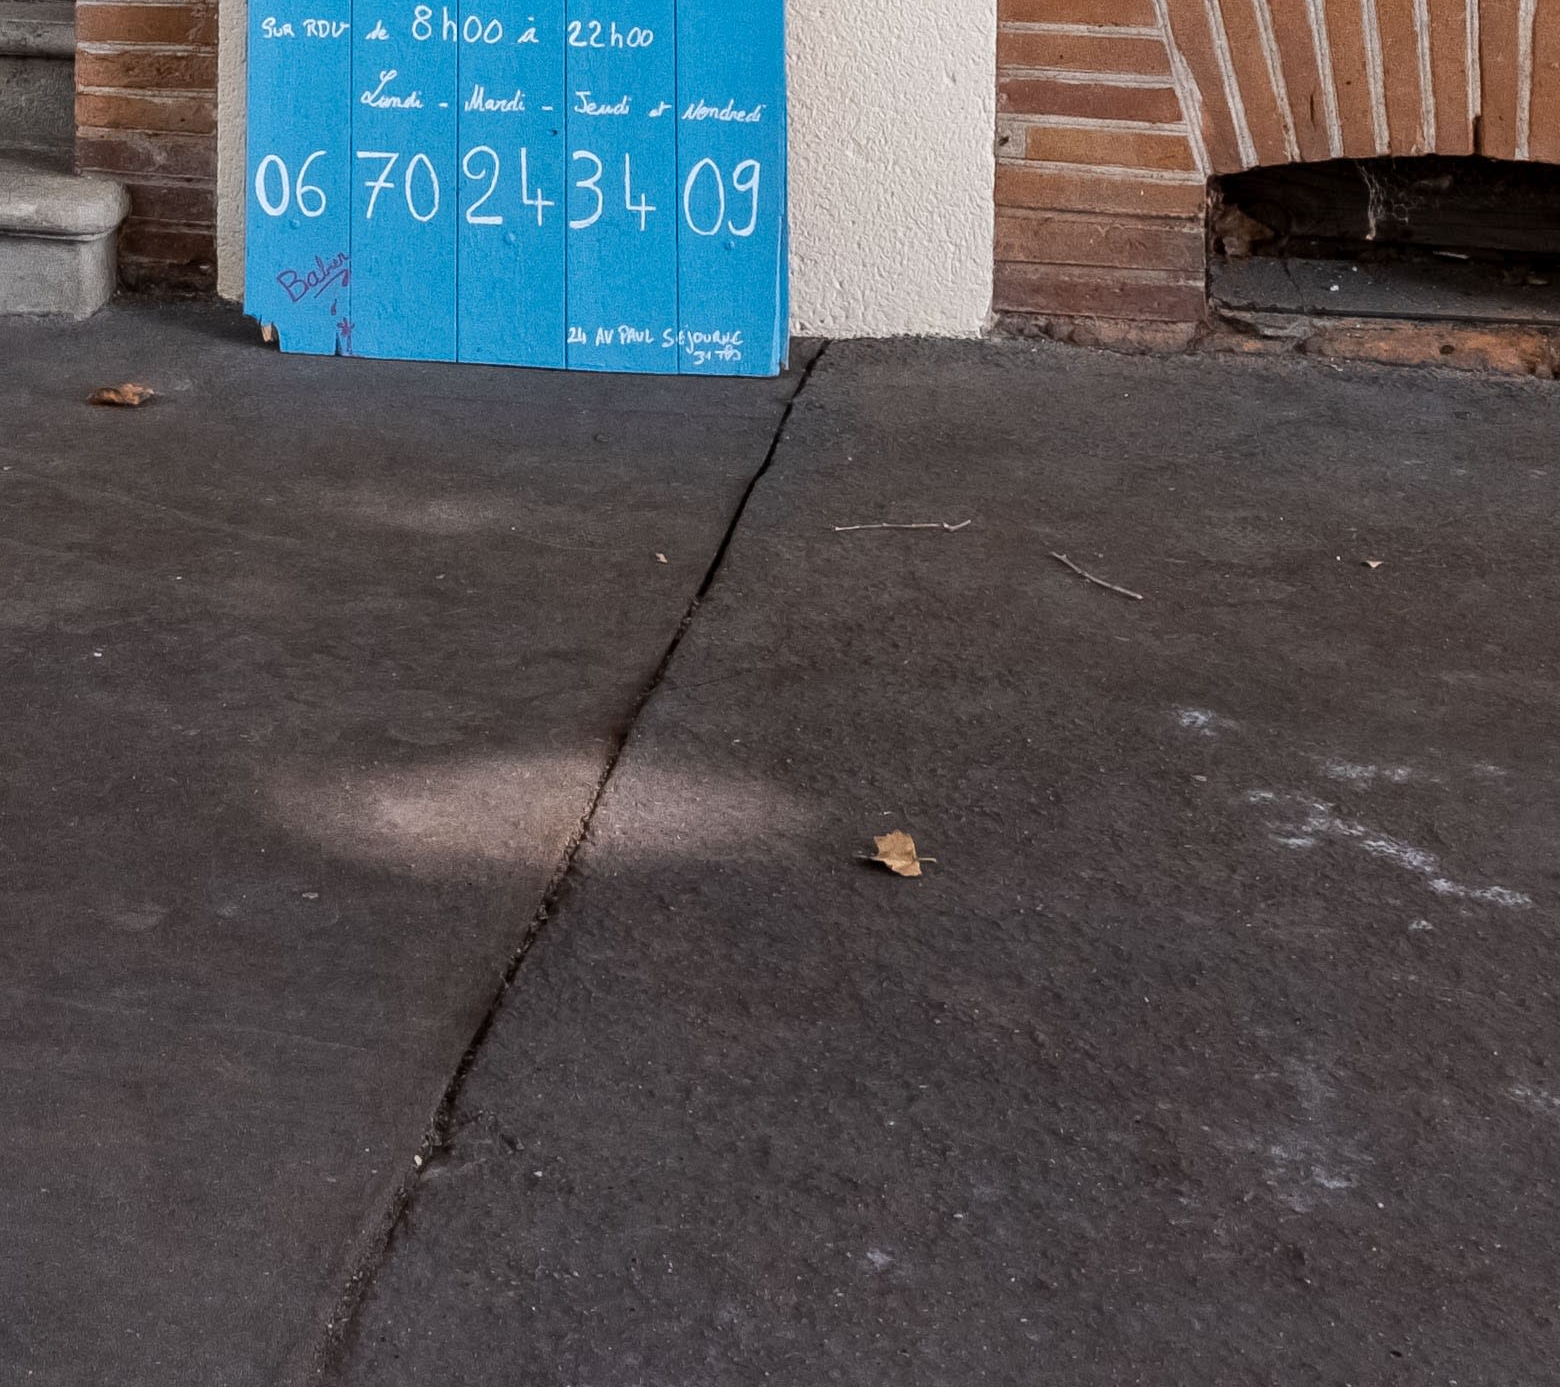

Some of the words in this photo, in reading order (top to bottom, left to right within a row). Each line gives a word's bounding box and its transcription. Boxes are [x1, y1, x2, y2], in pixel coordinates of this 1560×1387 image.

[303, 18, 351, 38] RDV
[365, 19, 391, 41] de
[567, 20, 655, 49] 22h00
[360, 68, 425, 109] Lundi
[464, 83, 526, 113] Mardi
[574, 90, 633, 116] Jeudi
[648, 100, 673, 119] et
[682, 98, 768, 123] Vendredi
[254, 148, 328, 219] 06
[356, 149, 441, 224] 70
[462, 145, 556, 227] 24
[569, 149, 657, 232] 34
[682, 157, 762, 237] 09
[567, 326, 588, 346] 24
[595, 326, 615, 347] AV
[618, 324, 655, 346] PAUL
